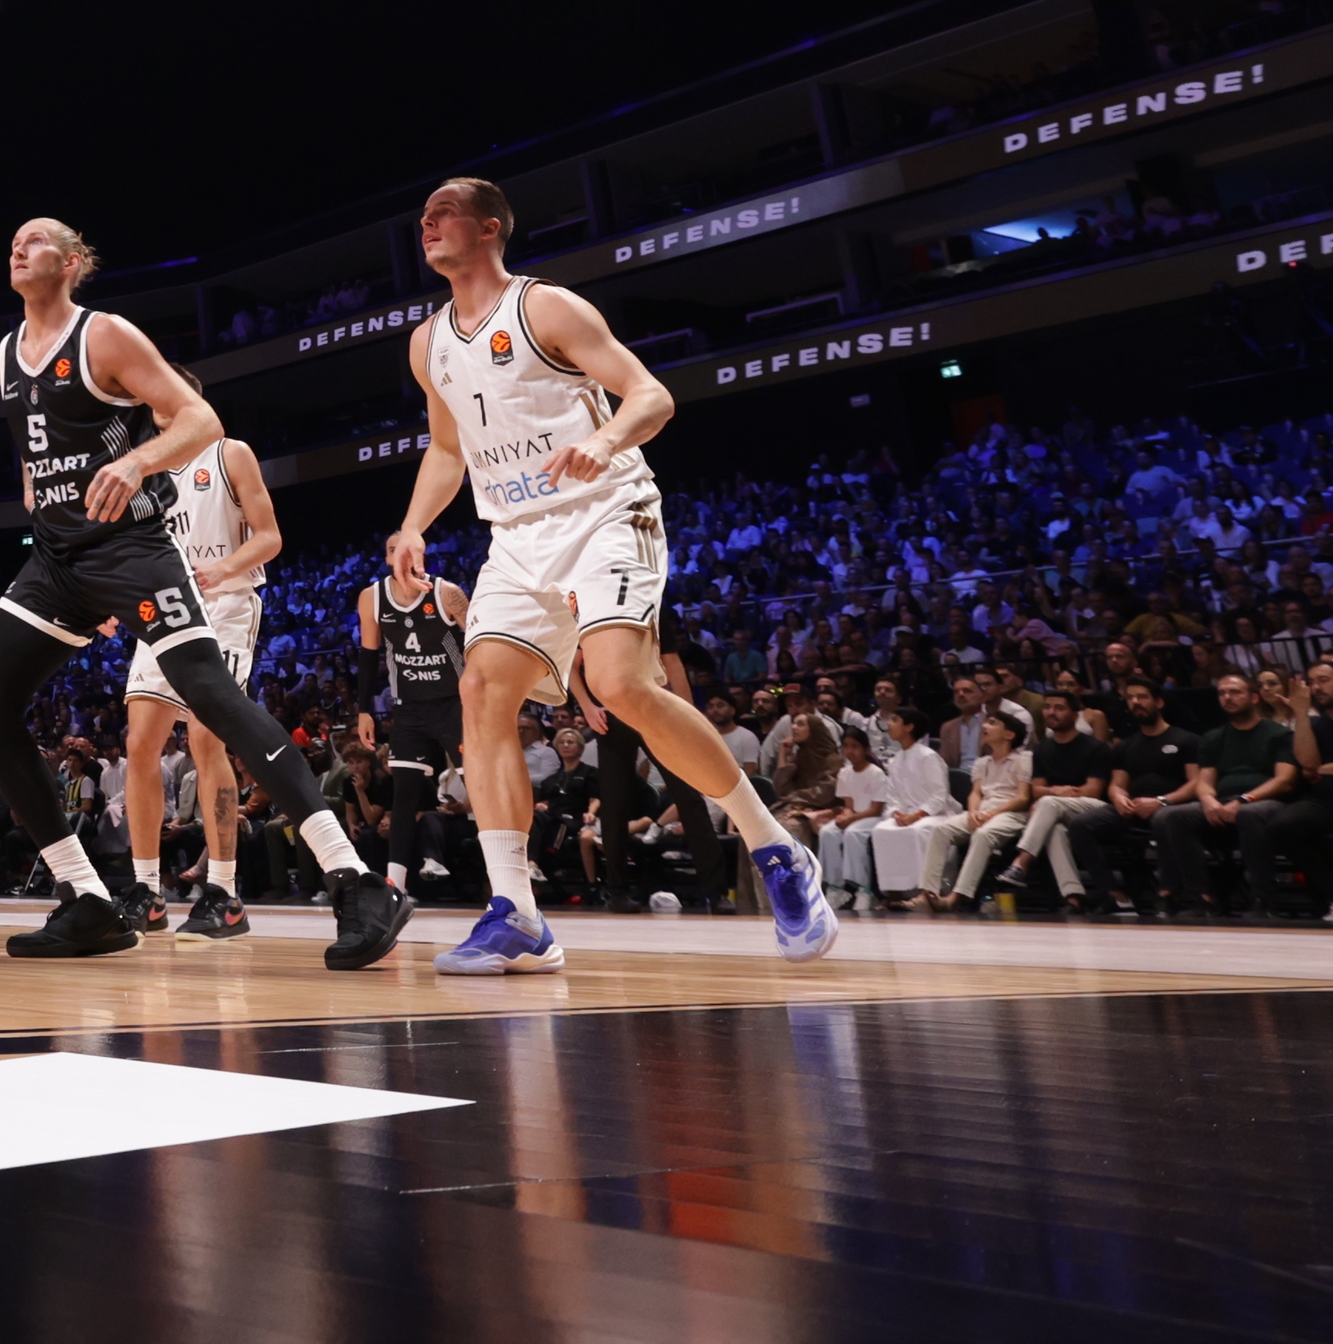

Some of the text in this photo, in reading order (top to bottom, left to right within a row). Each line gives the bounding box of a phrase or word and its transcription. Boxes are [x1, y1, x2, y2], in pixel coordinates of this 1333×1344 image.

[1003, 64, 1264, 153] DEFENSE!
[614, 197, 800, 263] DEFENSE!
[298, 302, 434, 352] DEFENSE!
[716, 323, 931, 385] DEFENSE!
[27, 413, 49, 453] 5
[46, 482, 80, 504] NIS
[175, 510, 190, 535] 11
[610, 568, 629, 605] 7
[154, 587, 192, 629] 5
[394, 653, 447, 667] MOZZART
[405, 632, 421, 653] 4
[418, 670, 441, 681] NIS
